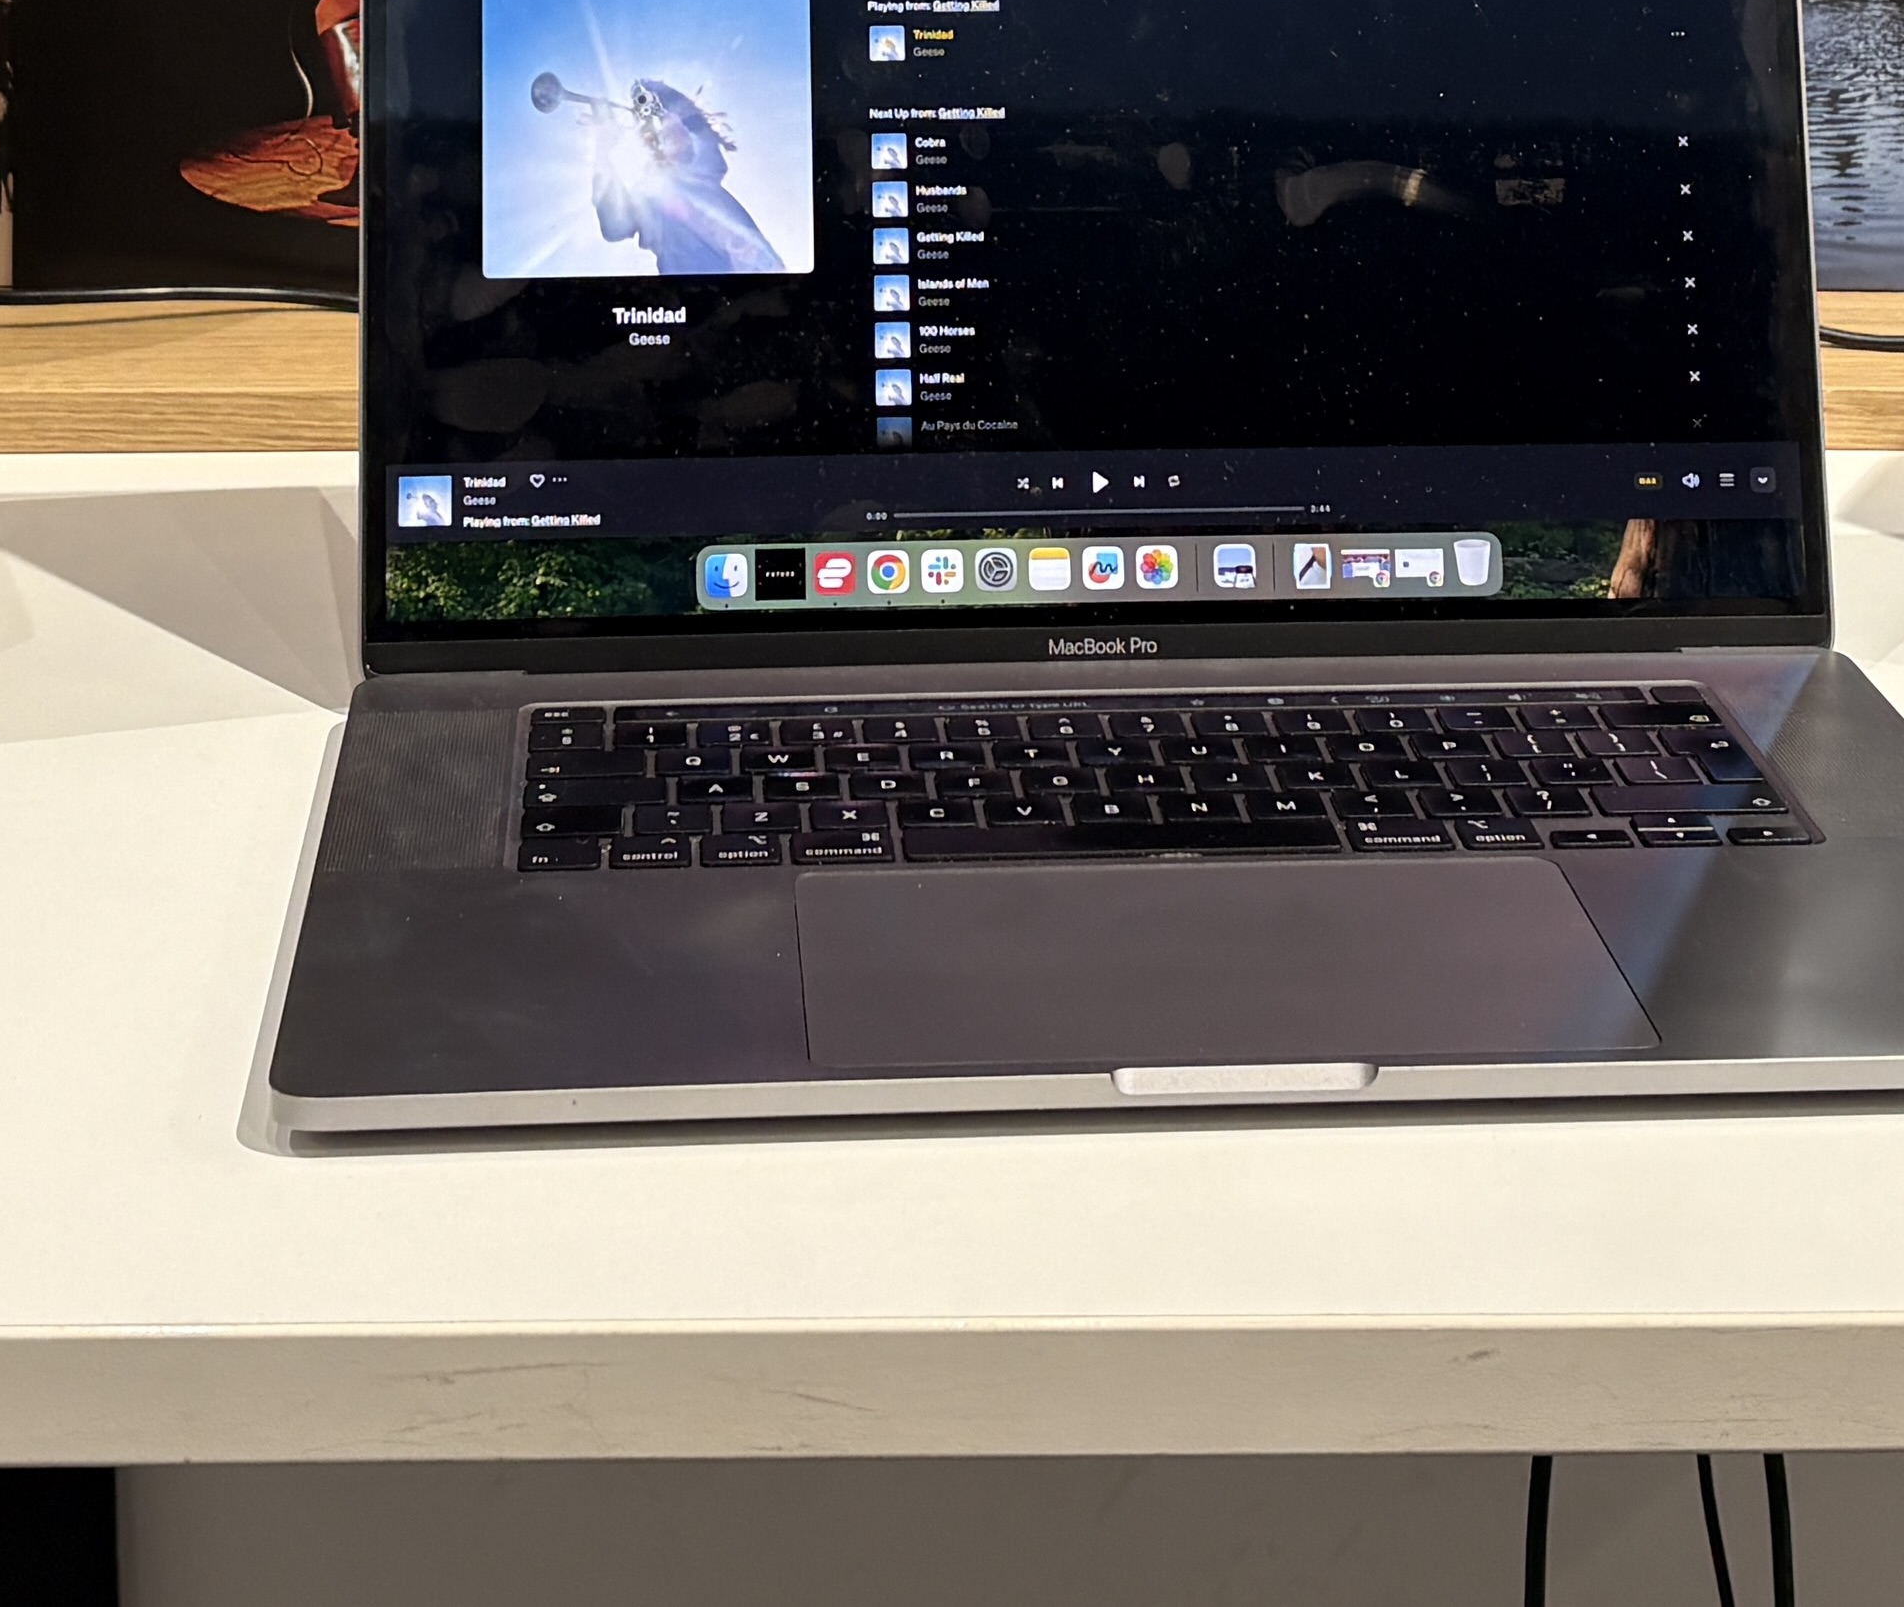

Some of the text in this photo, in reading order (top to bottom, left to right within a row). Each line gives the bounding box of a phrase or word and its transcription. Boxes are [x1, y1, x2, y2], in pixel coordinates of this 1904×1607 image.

[868, 0, 1000, 13] Playing from: Getting Killed
[913, 30, 954, 41] Trinidad
[913, 47, 945, 57] Geese
[870, 107, 1005, 120] Next Up from: Getting Killed
[915, 137, 946, 148] Cobra
[916, 155, 947, 165] Geese
[916, 185, 967, 196] Husbands
[916, 202, 948, 213] Geese
[917, 231, 984, 244] Getting Killed
[917, 250, 949, 260] Geese
[918, 278, 989, 290] Islands of Men
[918, 296, 950, 307] Geese
[612, 307, 686, 325] Trinidad
[919, 325, 975, 337] 100 Horses
[629, 333, 670, 346] Geese
[919, 344, 951, 354] Geese
[920, 372, 965, 384] Half Real
[920, 391, 952, 401] Geese
[921, 420, 1018, 433] Au Pays du Cocaine
[463, 477, 506, 488] Trinidad
[463, 495, 496, 506] Geese
[463, 515, 501, 529] Playing
[503, 515, 529, 526] from:
[571, 513, 600, 526] Killed
[1048, 636, 1158, 656] MacBook Pro
[1025, 749, 1037, 758] T
[768, 755, 788, 763] W
[1308, 772, 1323, 780] K
[1395, 770, 1408, 778] L
[1191, 803, 1207, 811] N
[1277, 801, 1296, 810] M
[843, 810, 856, 819] X
[1017, 807, 1032, 815] V
[755, 812, 768, 821] Z
[1364, 834, 1441, 844] command
[1475, 834, 1526, 843] option
[622, 851, 678, 861] control
[718, 850, 769, 860] option
[805, 846, 883, 856] command
[532, 855, 549, 864] fn
